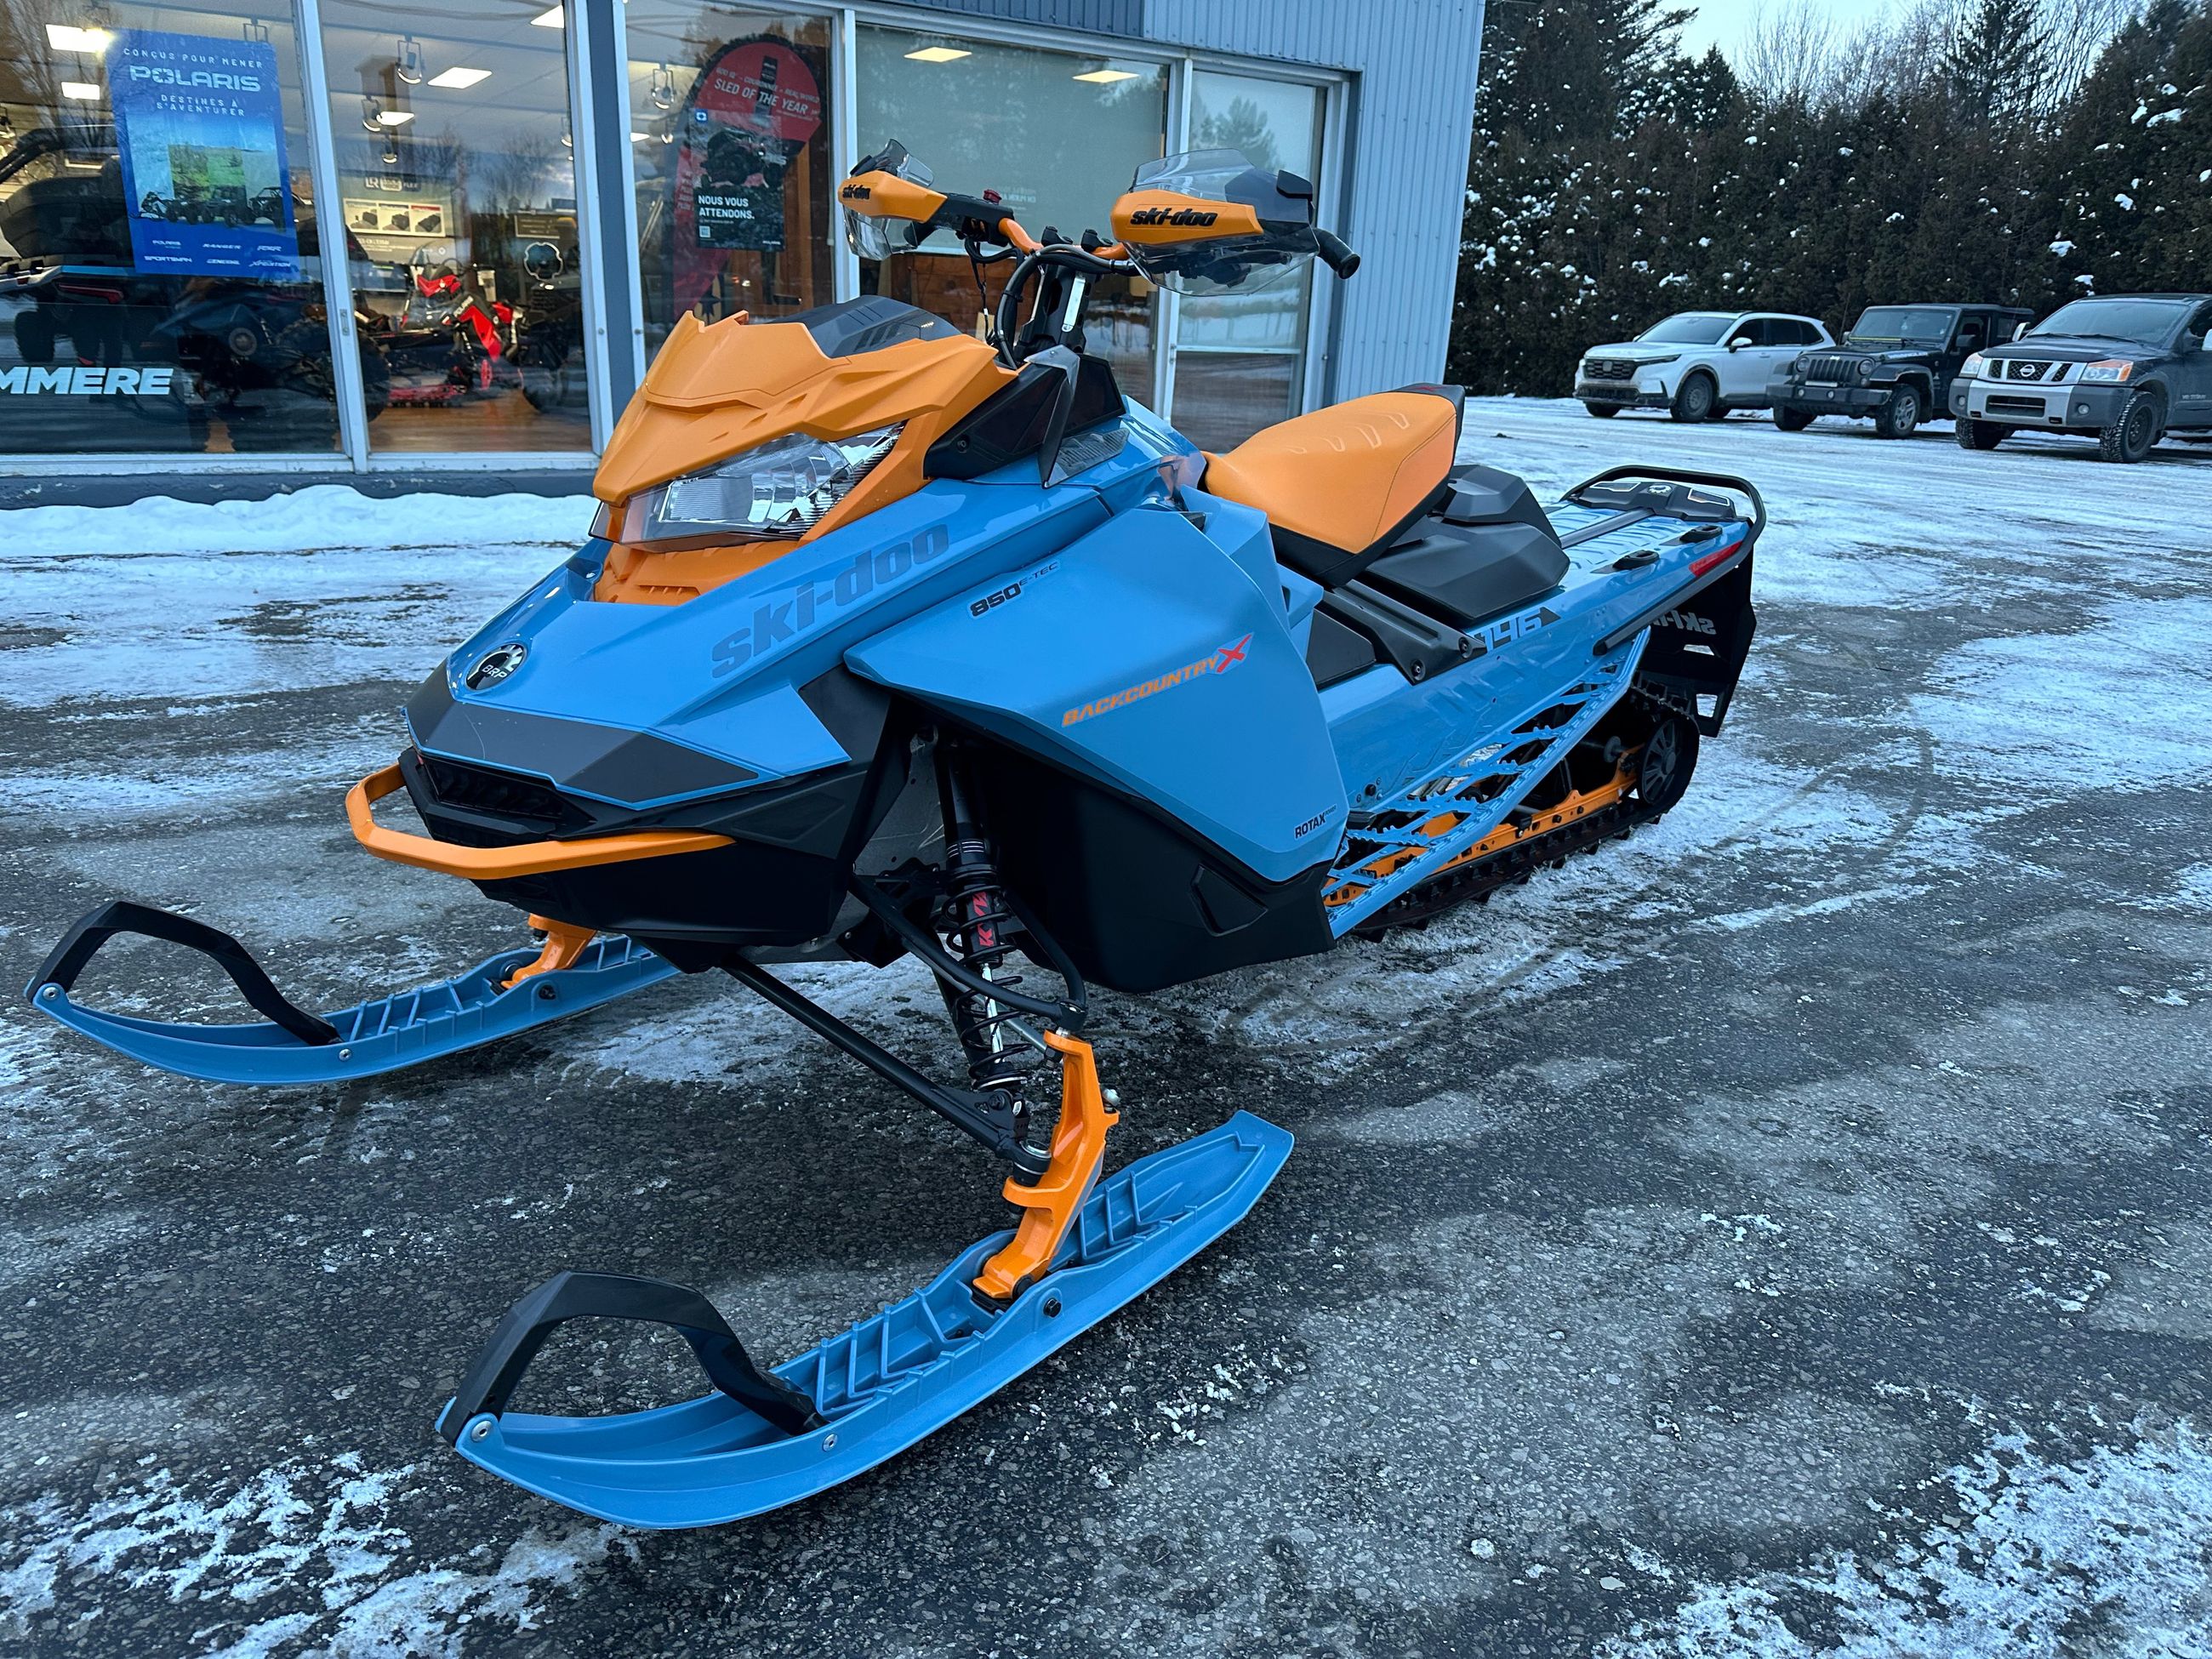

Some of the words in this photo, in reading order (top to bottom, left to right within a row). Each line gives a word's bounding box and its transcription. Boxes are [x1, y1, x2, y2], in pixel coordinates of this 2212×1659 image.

[123, 48, 174, 60] CONÇUS
[182, 54, 215, 64] POUR
[222, 58, 263, 69] MENER
[129, 65, 261, 92] POLARIS
[714, 78, 740, 94] SLED
[742, 87, 757, 99] OF
[759, 91, 779, 106] THE
[782, 99, 808, 114] YEAR
[157, 102, 245, 117] S'AVENTURER
[698, 195, 723, 206] NOUS
[725, 197, 749, 208] VOUS
[842, 184, 871, 200] ski-doo
[698, 208, 755, 219] ATTENDONS.
[1130, 208, 1218, 226] ski-doo
[970, 583, 1022, 617] 850
[1019, 562, 1058, 586] E-TEC
[712, 523, 949, 679] ski-doo
[482, 664, 508, 678] BRP
[1063, 653, 1220, 727] BACKCOUNTRY
[1295, 812, 1325, 839] ROTAX
